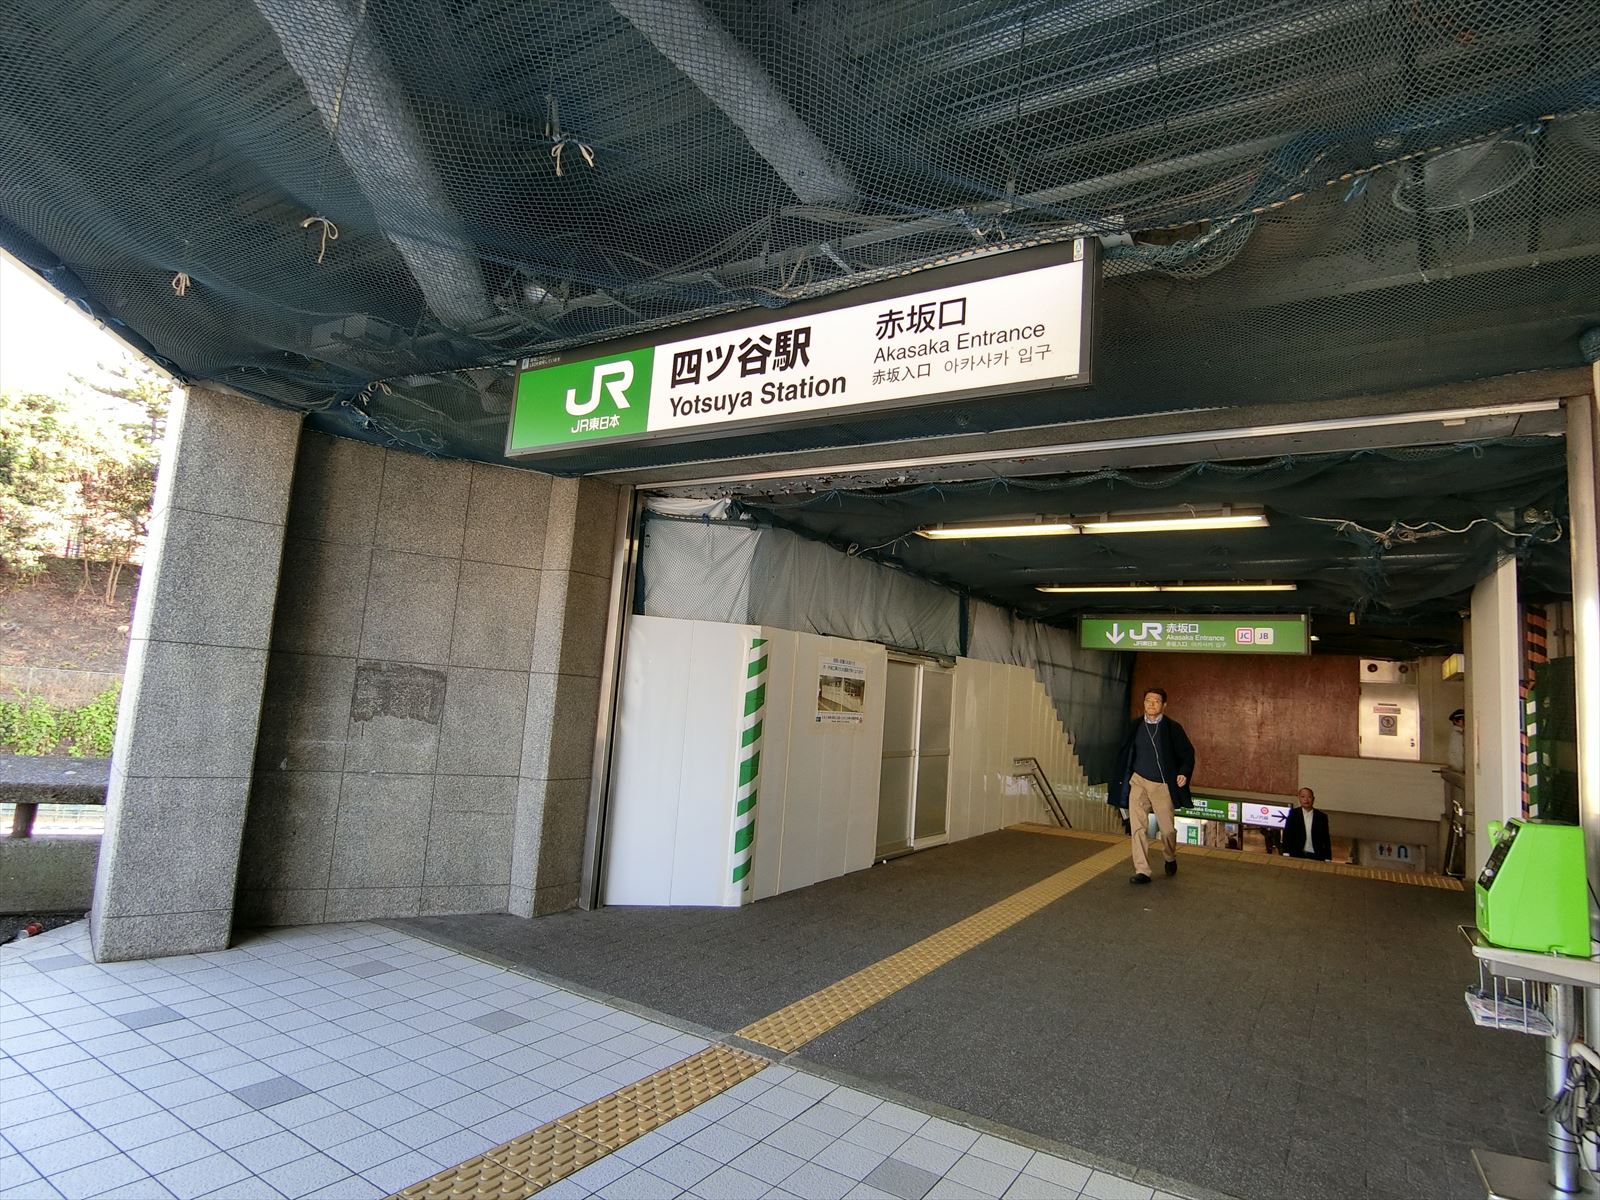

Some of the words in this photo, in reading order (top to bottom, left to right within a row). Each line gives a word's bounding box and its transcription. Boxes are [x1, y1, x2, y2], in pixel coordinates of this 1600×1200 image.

[875, 297, 967, 340] 赤坂口
[873, 339, 950, 364] Akasaka
[957, 323, 1045, 350] Entrance
[670, 326, 811, 389] 四ツ谷駅
[944, 350, 1009, 374] 아카사카
[1018, 343, 1052, 364] 입구
[565, 359, 635, 416] JR
[871, 363, 931, 386] 赤坂入口
[670, 390, 752, 417] Yotsuya
[760, 375, 846, 405] Station
[571, 414, 620, 433] JR東日本
[1129, 622, 1162, 640] JR
[1166, 623, 1199, 634] 赤坂口
[1239, 631, 1250, 640] JC
[1258, 631, 1269, 640] JB
